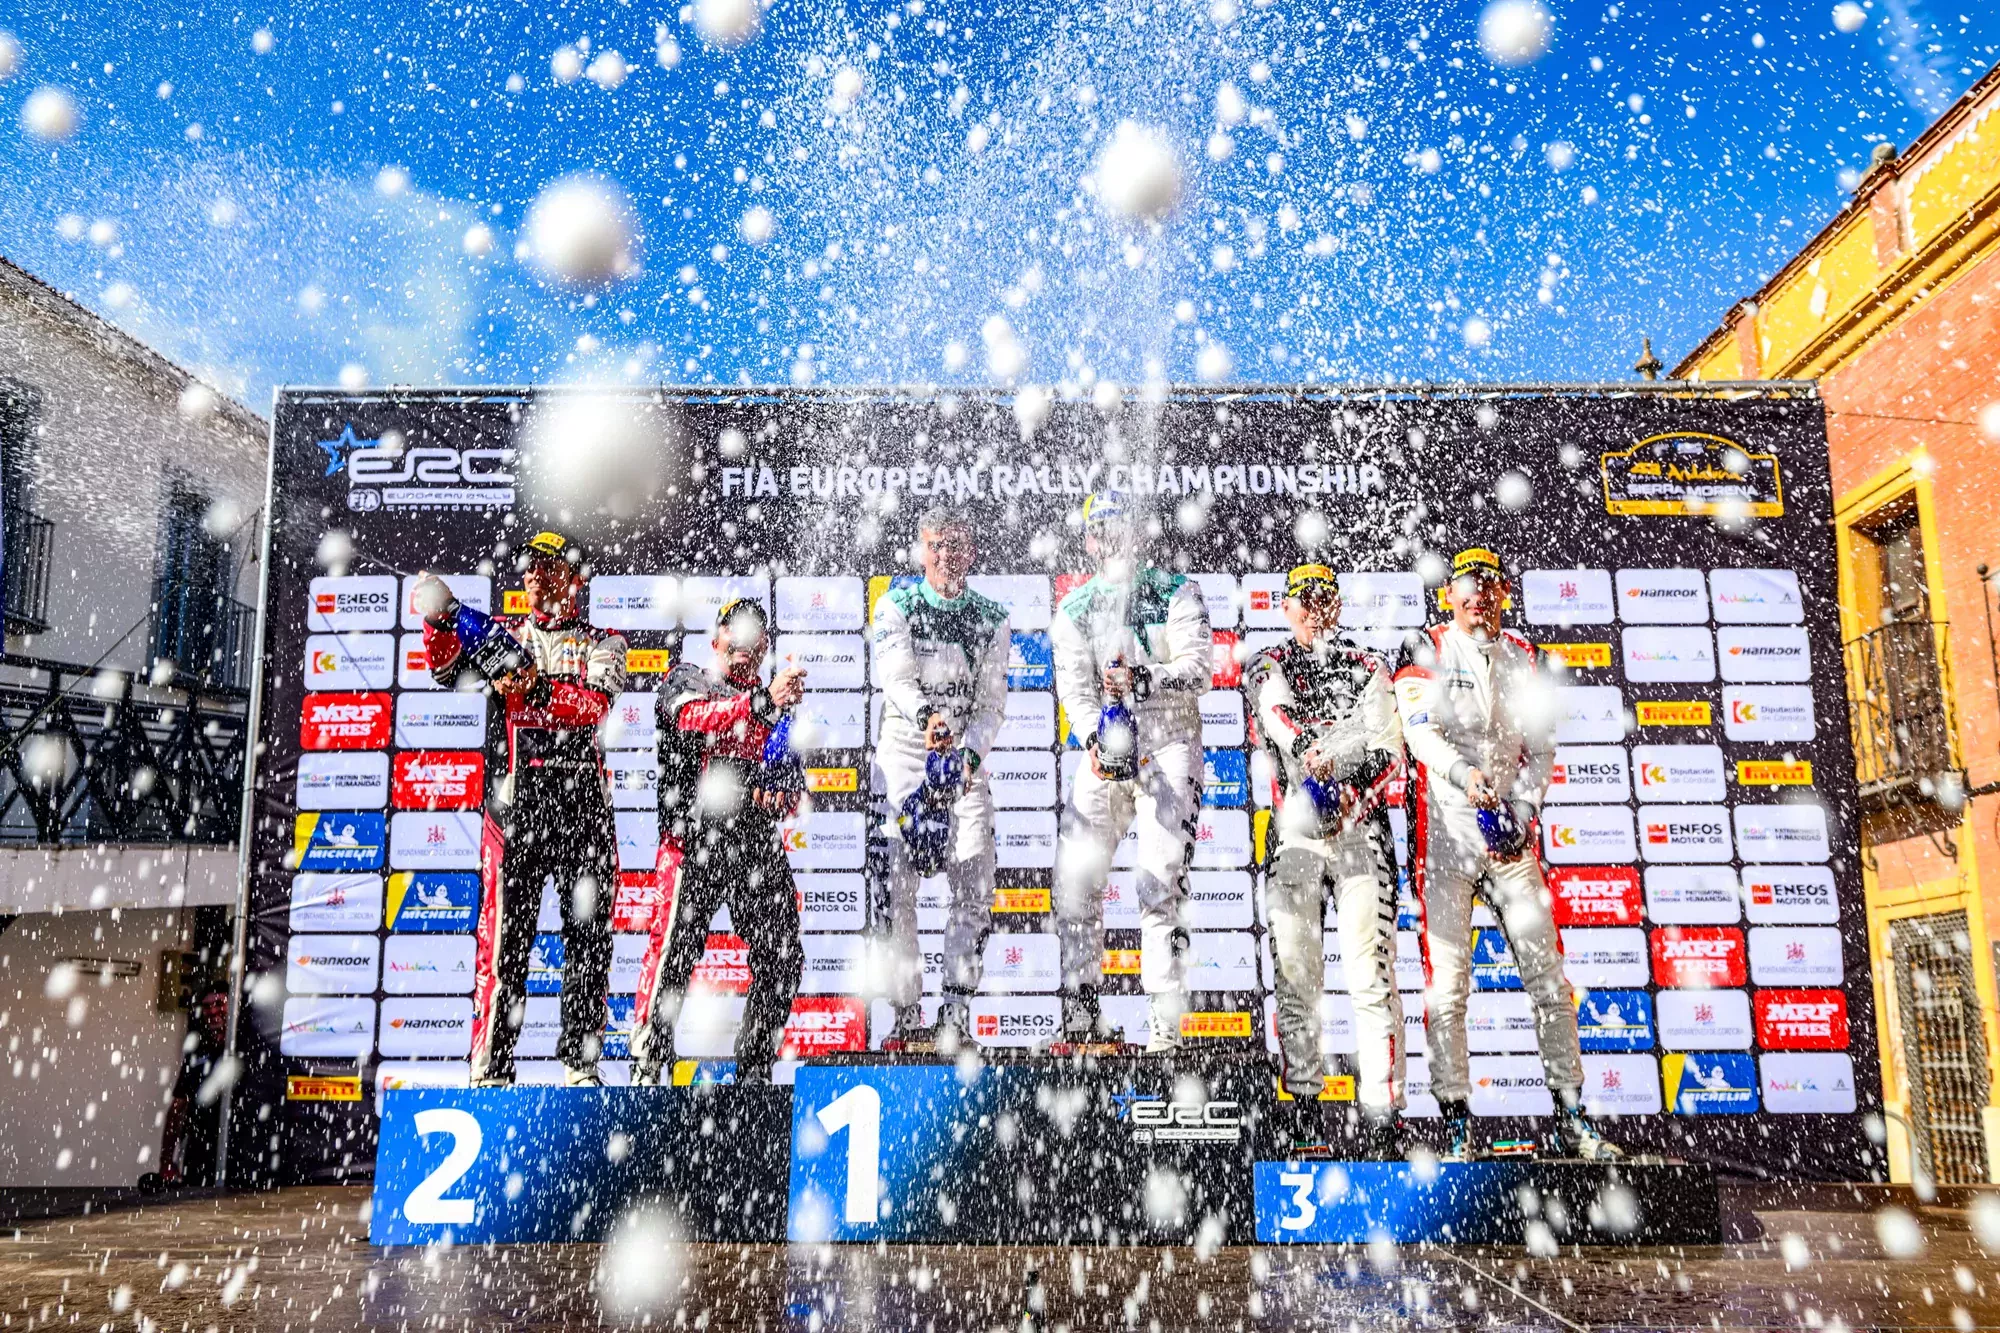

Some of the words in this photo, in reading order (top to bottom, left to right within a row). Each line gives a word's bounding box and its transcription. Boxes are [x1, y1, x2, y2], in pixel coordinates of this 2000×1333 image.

[348, 448, 515, 482] ERC
[722, 468, 778, 496] FIA
[791, 466, 978, 496] EUROPEAN
[992, 465, 1100, 494] RALLY
[1108, 464, 1382, 494] CHAMPIONSHIP
[1627, 484, 1685, 494] SIERRA
[1687, 485, 1758, 498] MORENA
[336, 593, 389, 604] ENEOS
[374, 605, 389, 613] OIL
[311, 705, 382, 721] MRF
[318, 724, 370, 736] TYRES
[404, 764, 476, 780] MRF
[1567, 764, 1620, 775] ENEOS
[413, 783, 466, 796] TYRES
[1669, 824, 1722, 834] ENEOS
[308, 848, 378, 858] MICHELIN
[1559, 881, 1631, 897] MRF
[1774, 885, 1828, 895] ENEOS
[805, 891, 858, 902] ENEOS
[804, 904, 838, 912] MOTOR
[843, 904, 857, 912] OIL
[1570, 901, 1622, 912] TYRES
[401, 910, 471, 919] MICHELIN
[1663, 941, 1736, 957] MRF
[1767, 1004, 1838, 1021] MRF
[785, 1012, 855, 1029] MRF
[1000, 1015, 1054, 1026] ENEOS
[1039, 1028, 1055, 1036] OIL
[1578, 1029, 1650, 1038] MICHELIN
[1776, 1024, 1830, 1036] TYRES
[792, 1033, 845, 1044] TYRES
[1681, 1092, 1750, 1101] MICHELIN
[1132, 1102, 1238, 1124] ERC
[816, 1084, 881, 1223] 1
[403, 1108, 482, 1224] 2
[1280, 1173, 1317, 1230] 3
